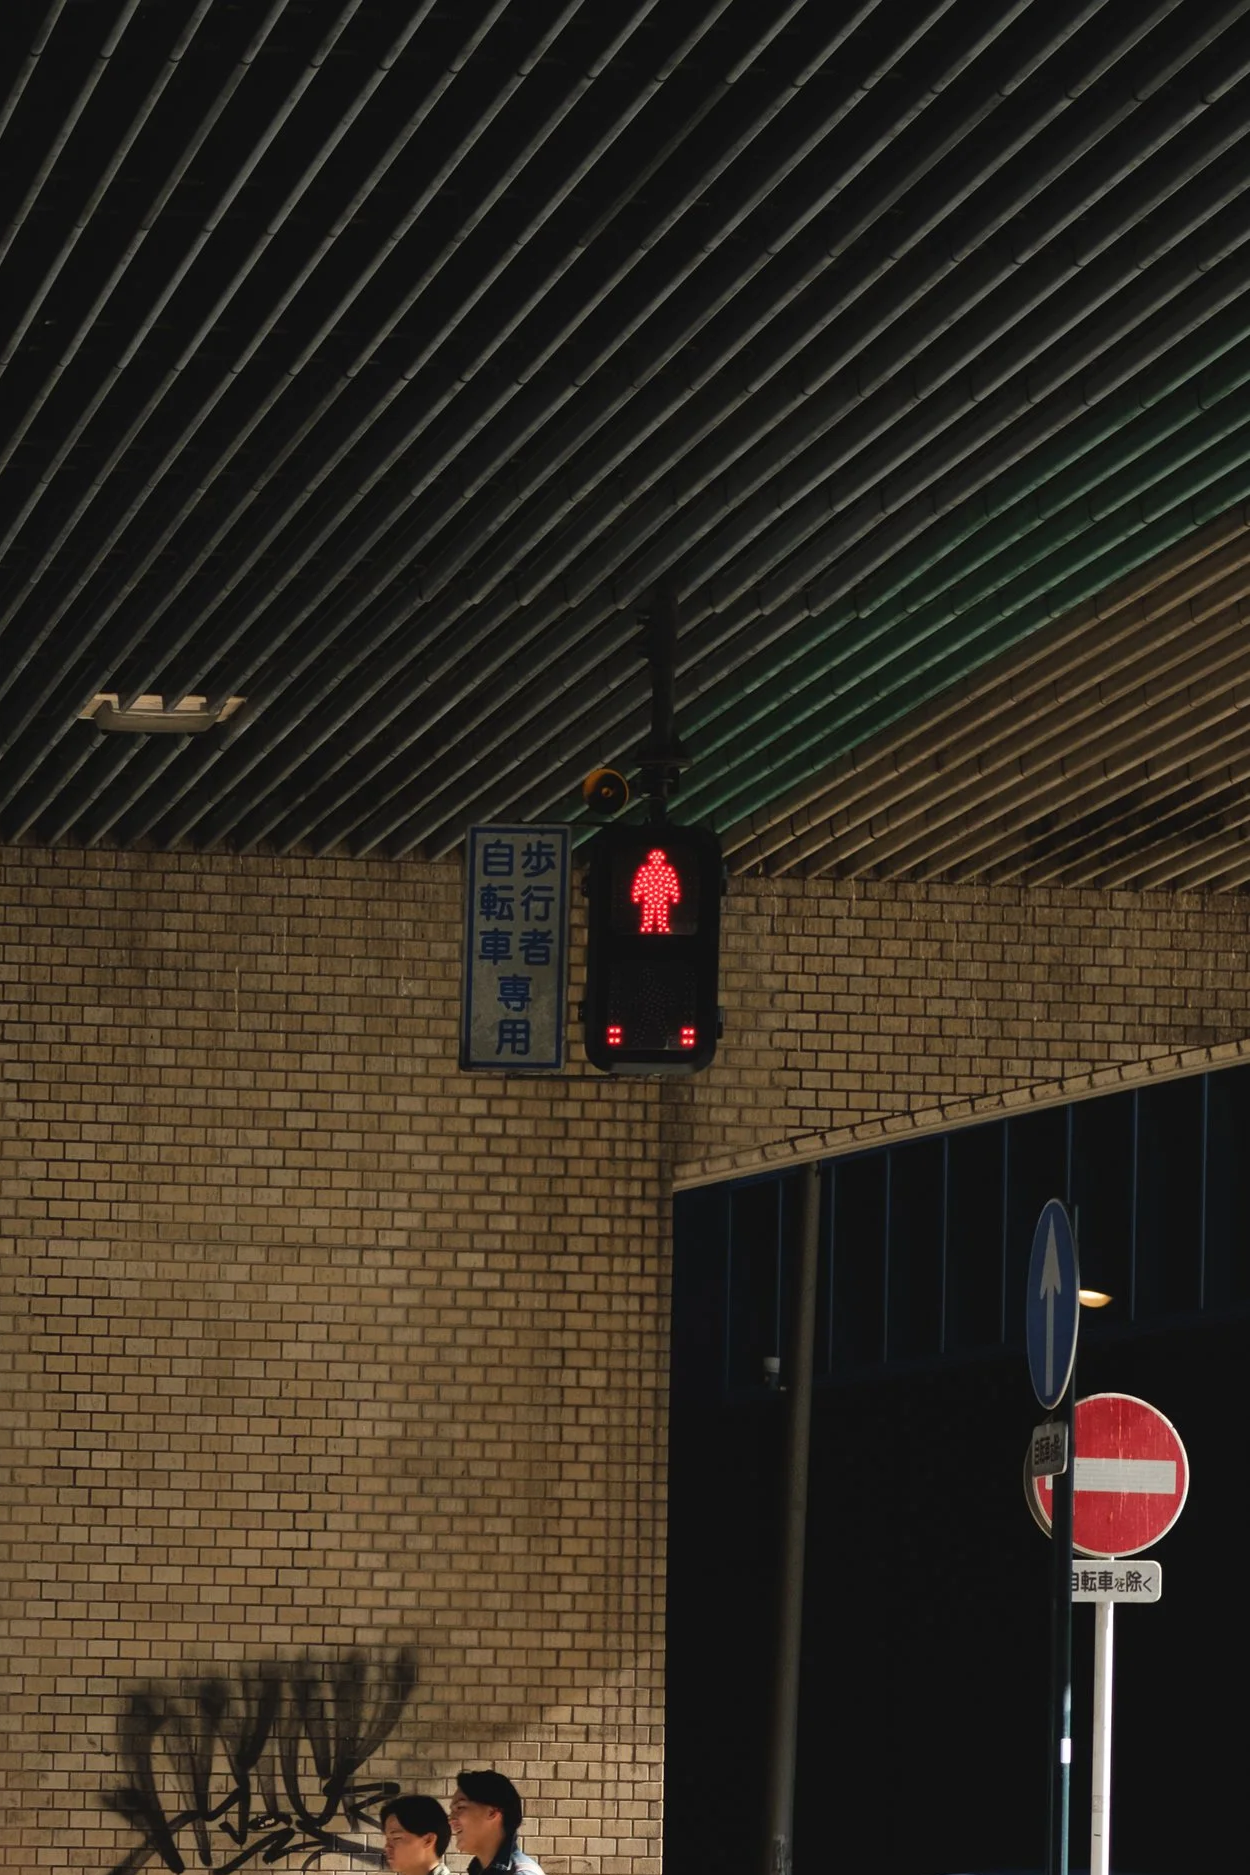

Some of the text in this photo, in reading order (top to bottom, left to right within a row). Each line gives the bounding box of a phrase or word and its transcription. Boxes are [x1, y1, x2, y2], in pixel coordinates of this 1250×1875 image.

[478, 838, 515, 966] 自転車
[518, 839, 557, 967] 歩行者
[495, 973, 533, 1056] 専用
